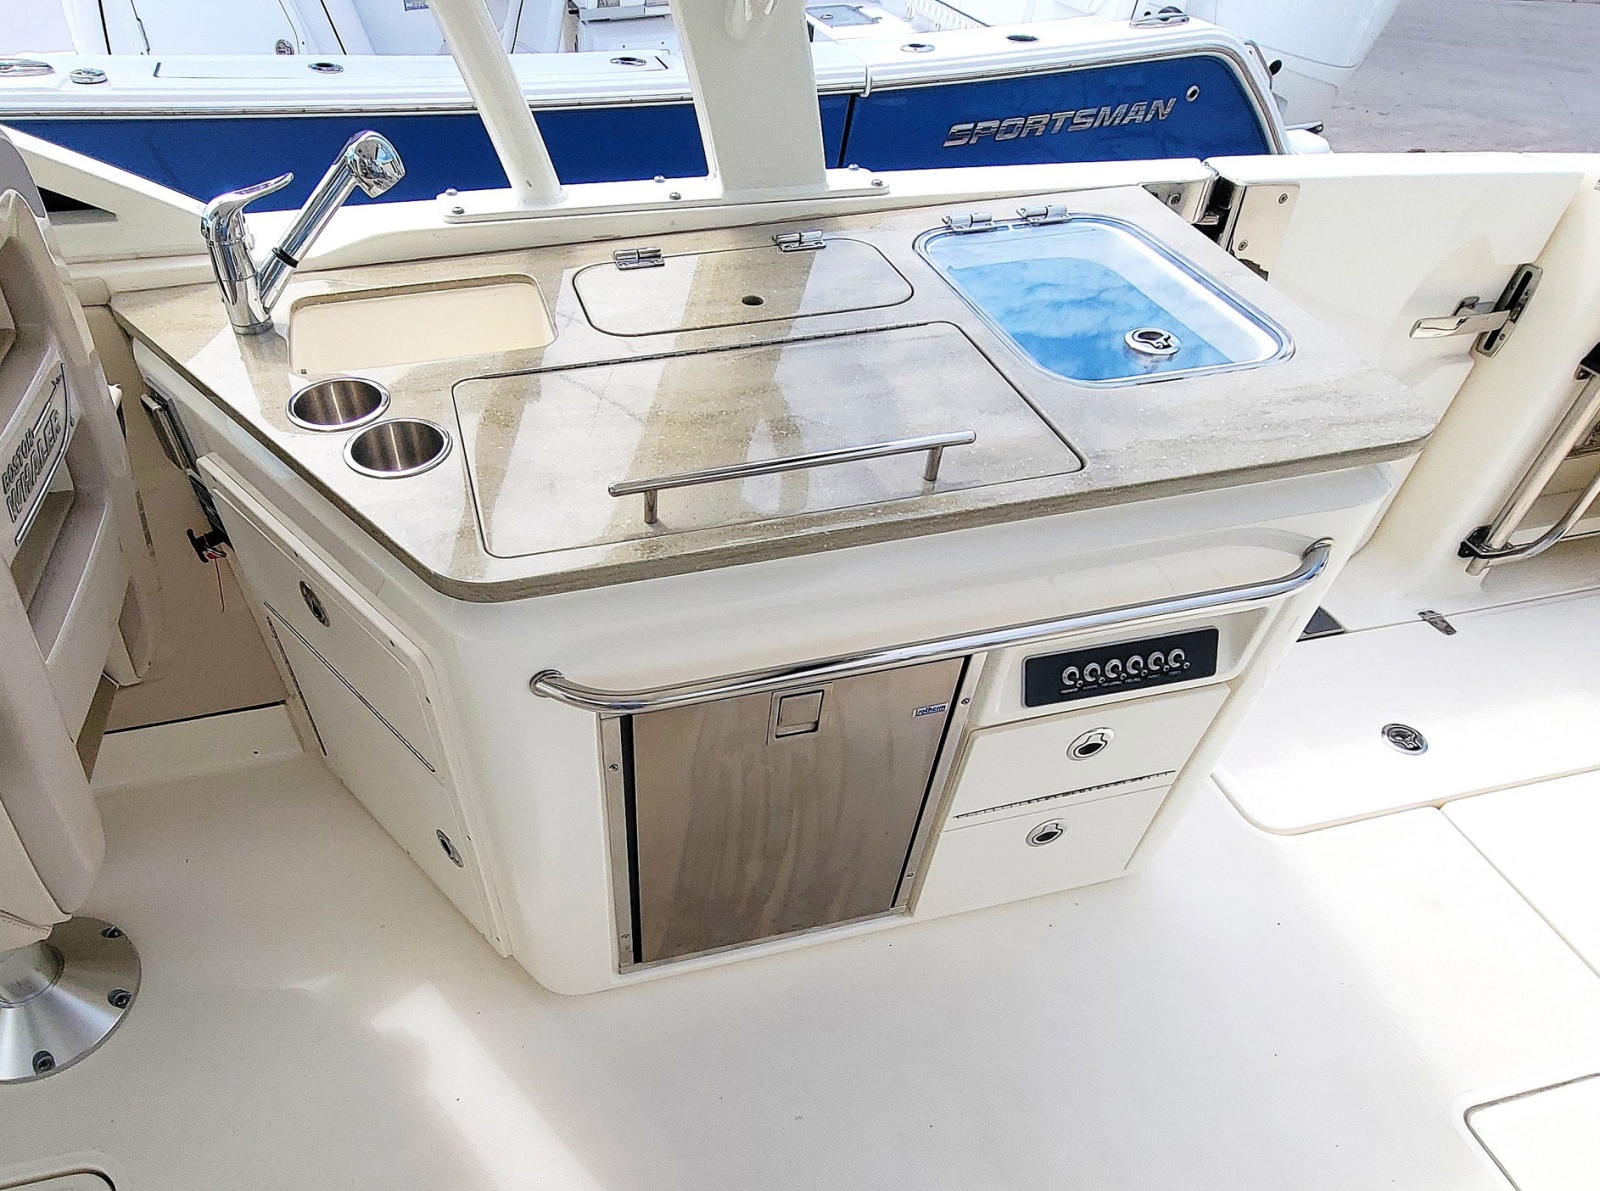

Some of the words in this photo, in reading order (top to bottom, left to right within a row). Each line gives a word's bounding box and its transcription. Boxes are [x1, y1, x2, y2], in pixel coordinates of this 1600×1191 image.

[943, 98, 1177, 147] SPORTSMAN
[2, 428, 35, 495] BOSTON
[6, 408, 61, 523] WHALER
